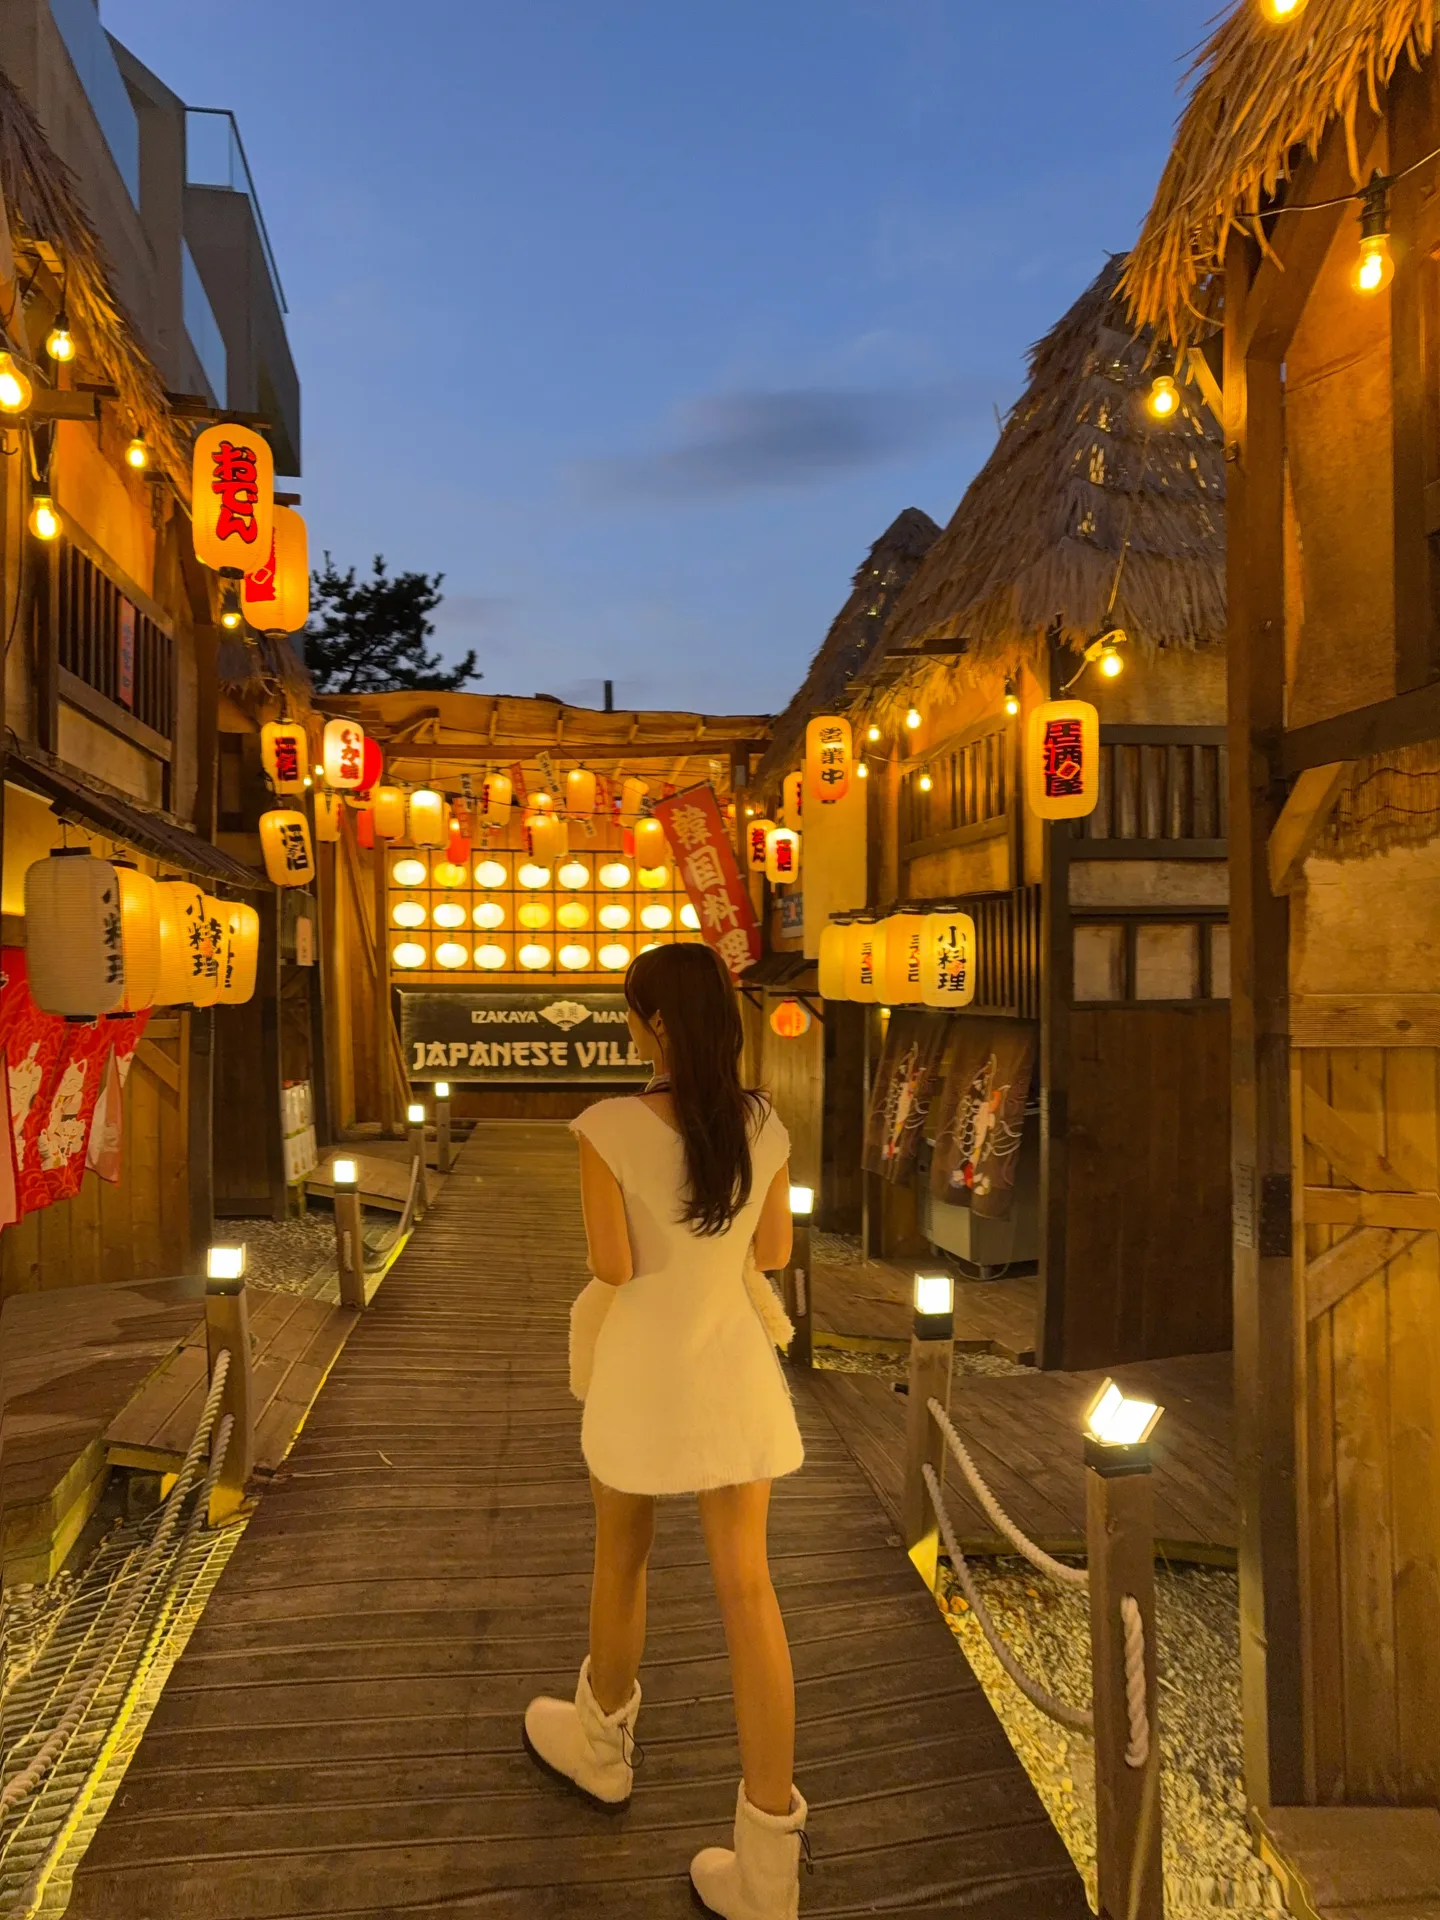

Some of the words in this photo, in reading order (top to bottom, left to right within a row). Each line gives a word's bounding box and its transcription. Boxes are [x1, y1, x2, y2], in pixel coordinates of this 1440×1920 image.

[211, 440, 258, 544] おでん
[819, 727, 844, 785] 営業中
[1042, 719, 1083, 798] 居酒屋
[937, 925, 967, 992] 小料理
[471, 1010, 539, 1024] IZAKAYA
[412, 1041, 568, 1071] JAPANESE
[574, 1041, 653, 1068] VILL
